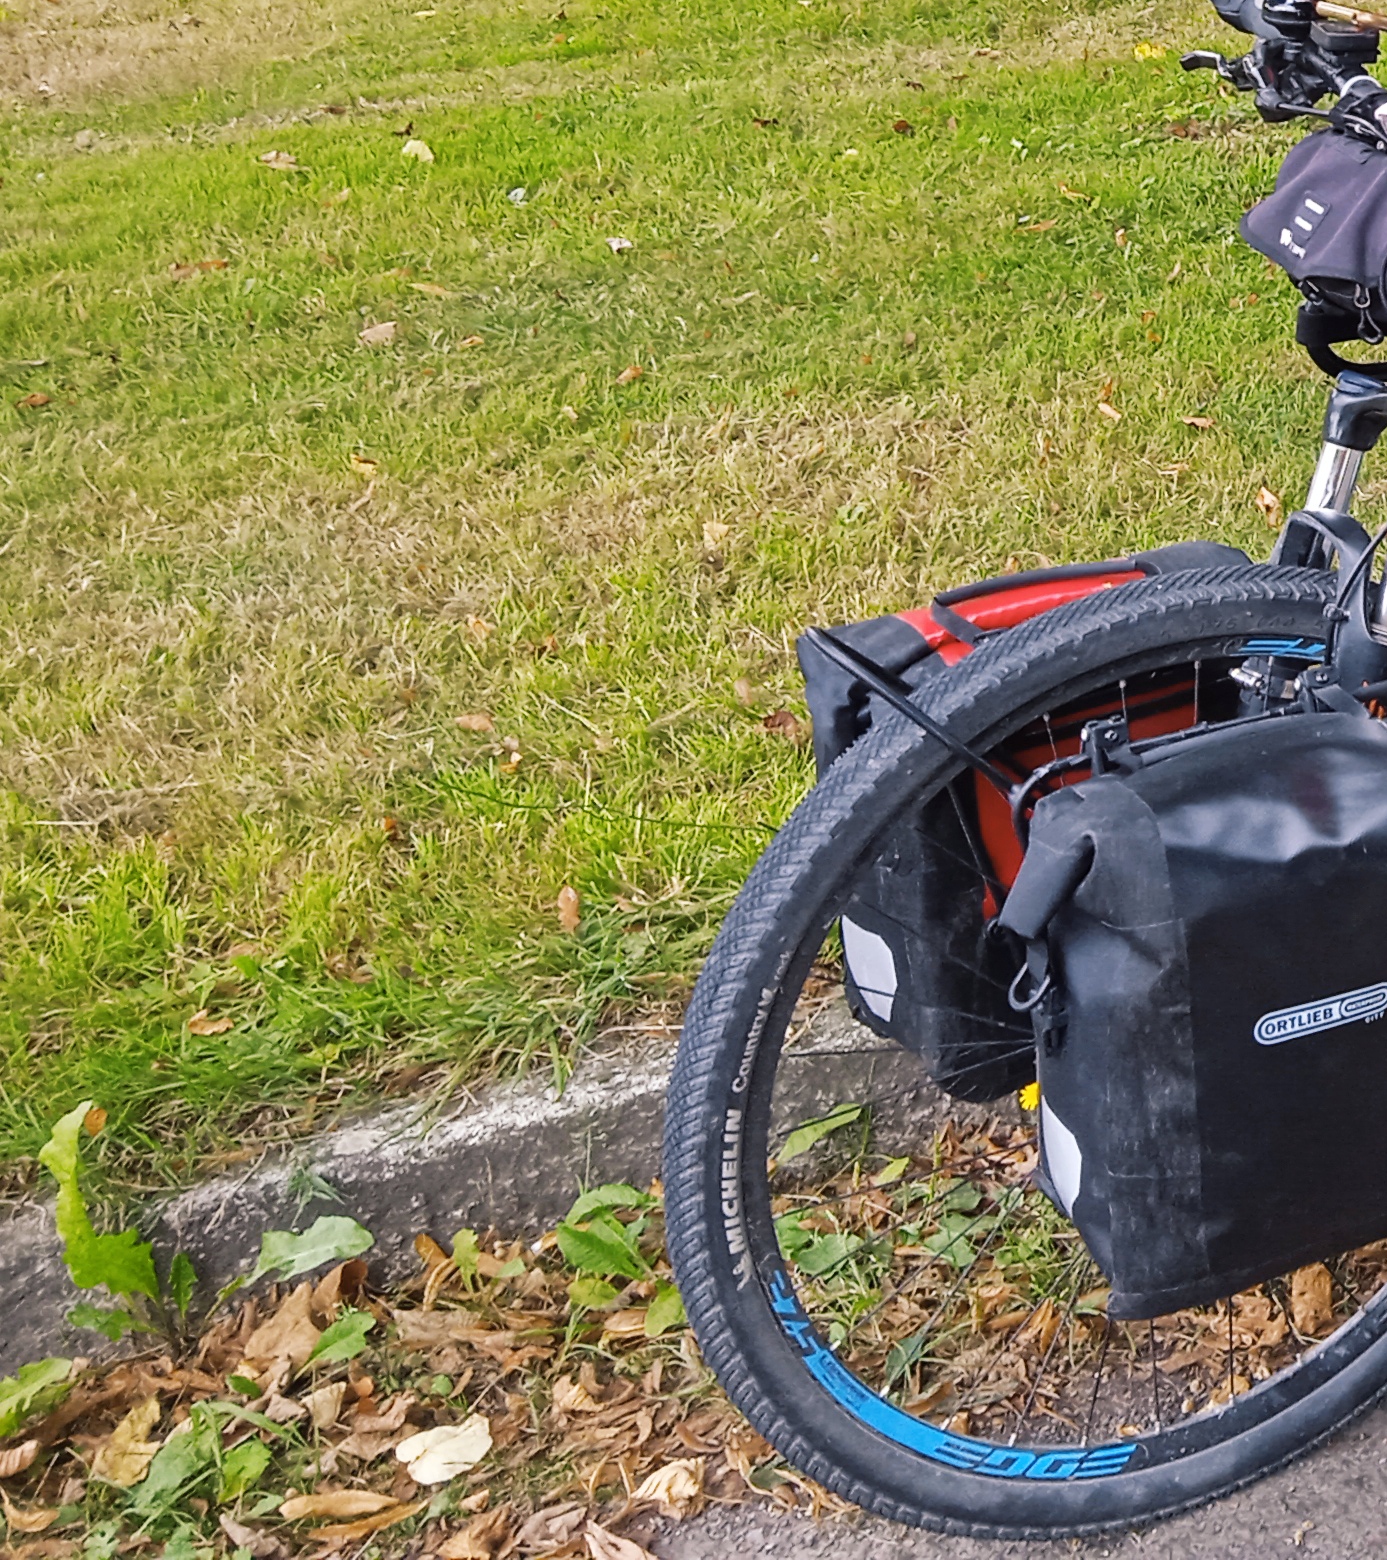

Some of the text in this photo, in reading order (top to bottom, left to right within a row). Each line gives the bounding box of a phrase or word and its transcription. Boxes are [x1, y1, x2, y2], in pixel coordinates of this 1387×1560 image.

[732, 1008, 768, 1094] Country
[1264, 1007, 1334, 1035] ORTLIEB
[721, 1108, 746, 1256] MICHELIN
